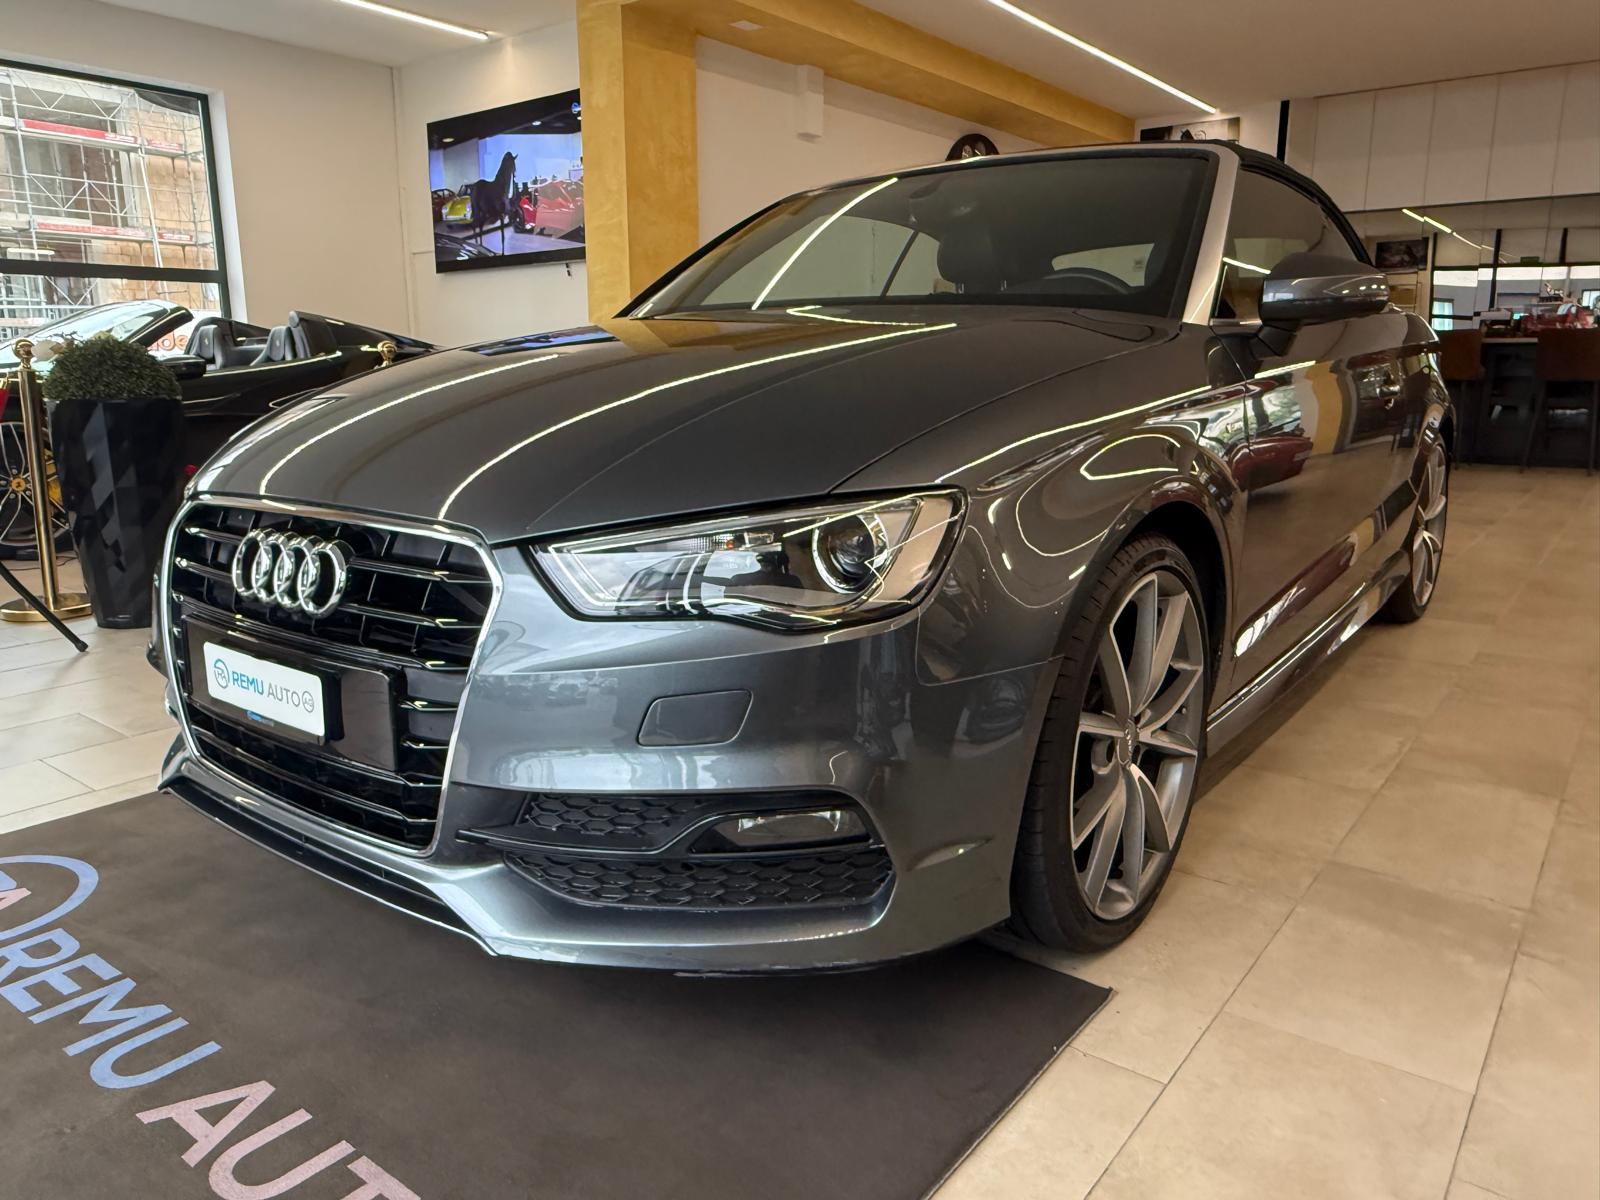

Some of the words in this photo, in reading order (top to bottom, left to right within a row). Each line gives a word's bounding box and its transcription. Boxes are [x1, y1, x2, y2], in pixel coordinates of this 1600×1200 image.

[231, 670, 265, 696] REMU
[267, 682, 301, 708] AUTO
[0, 928, 223, 1089] REMU
